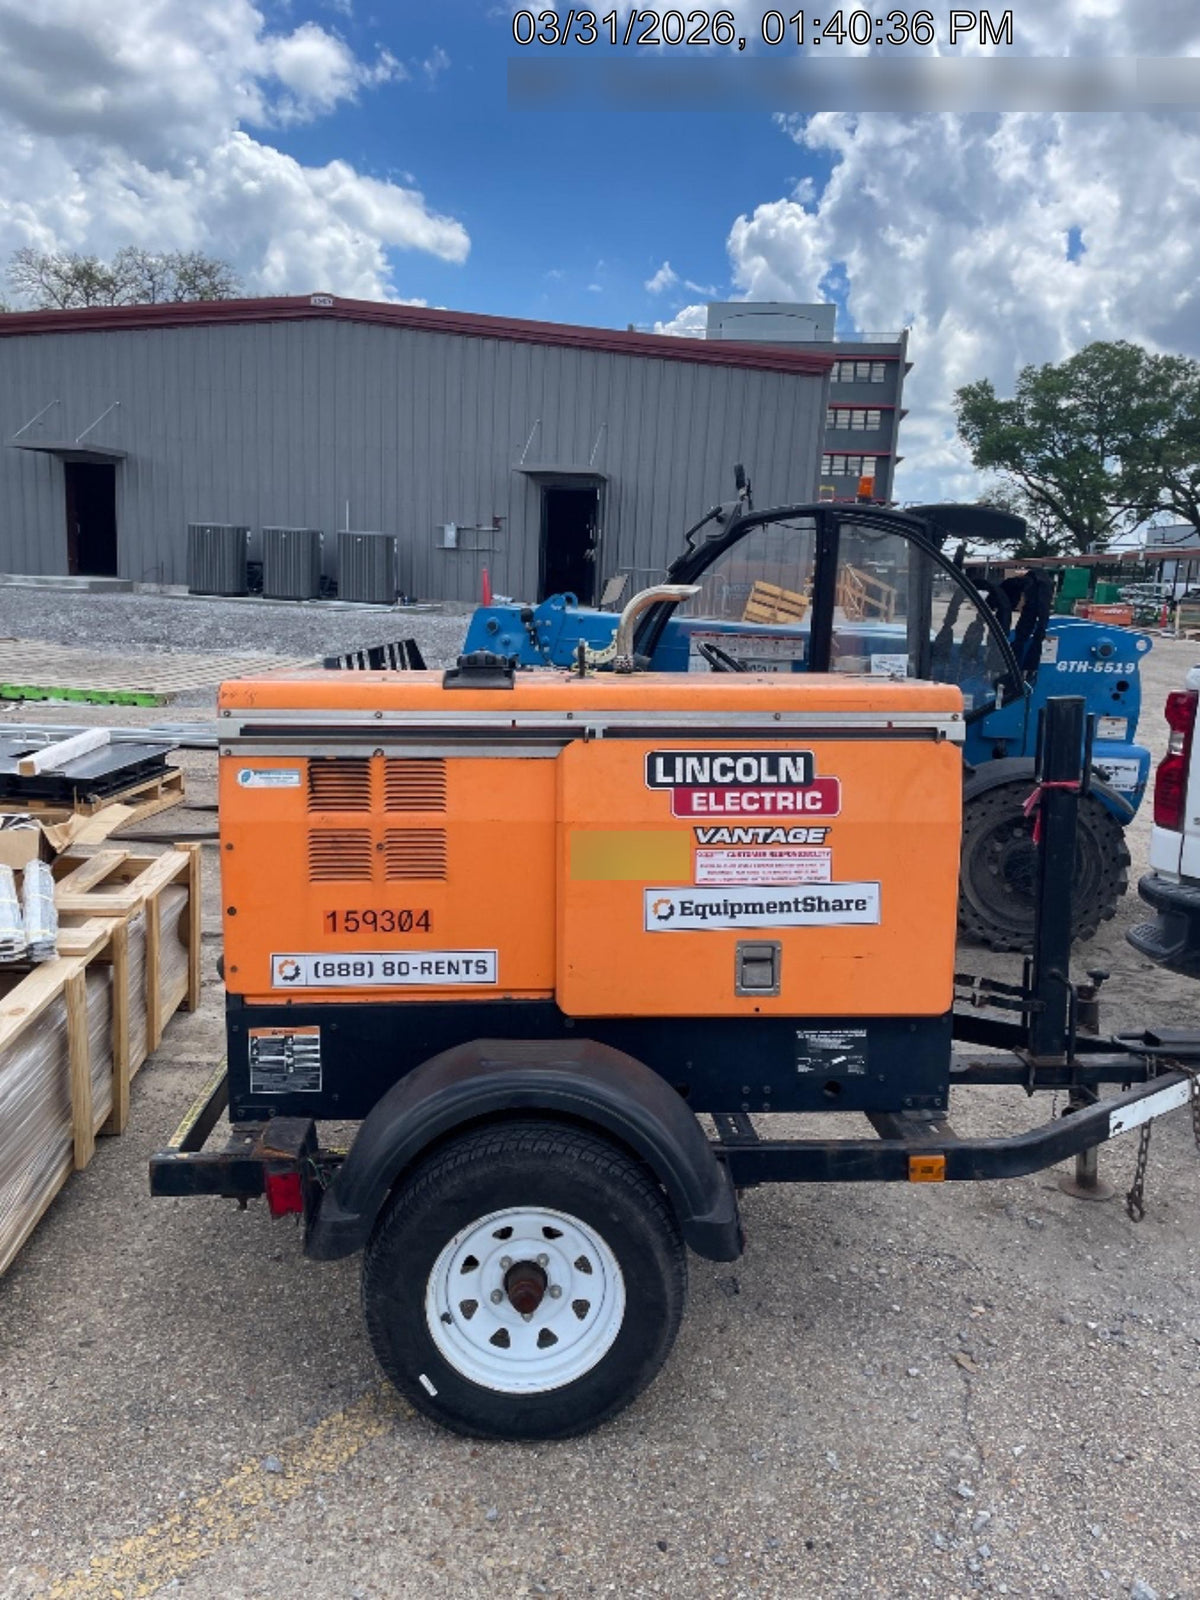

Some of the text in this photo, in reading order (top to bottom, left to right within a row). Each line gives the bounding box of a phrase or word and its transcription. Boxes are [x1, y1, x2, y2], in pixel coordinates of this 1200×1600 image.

[1056, 660, 1136, 674] GTH-5519
[655, 756, 805, 783] LINCOLN
[691, 790, 823, 812] ELECTRIC
[694, 826, 827, 845] VANTAGE
[678, 896, 868, 920] EquipmentShare
[326, 909, 432, 933] 159304
[313, 958, 489, 979] (888) 80-RENTS
